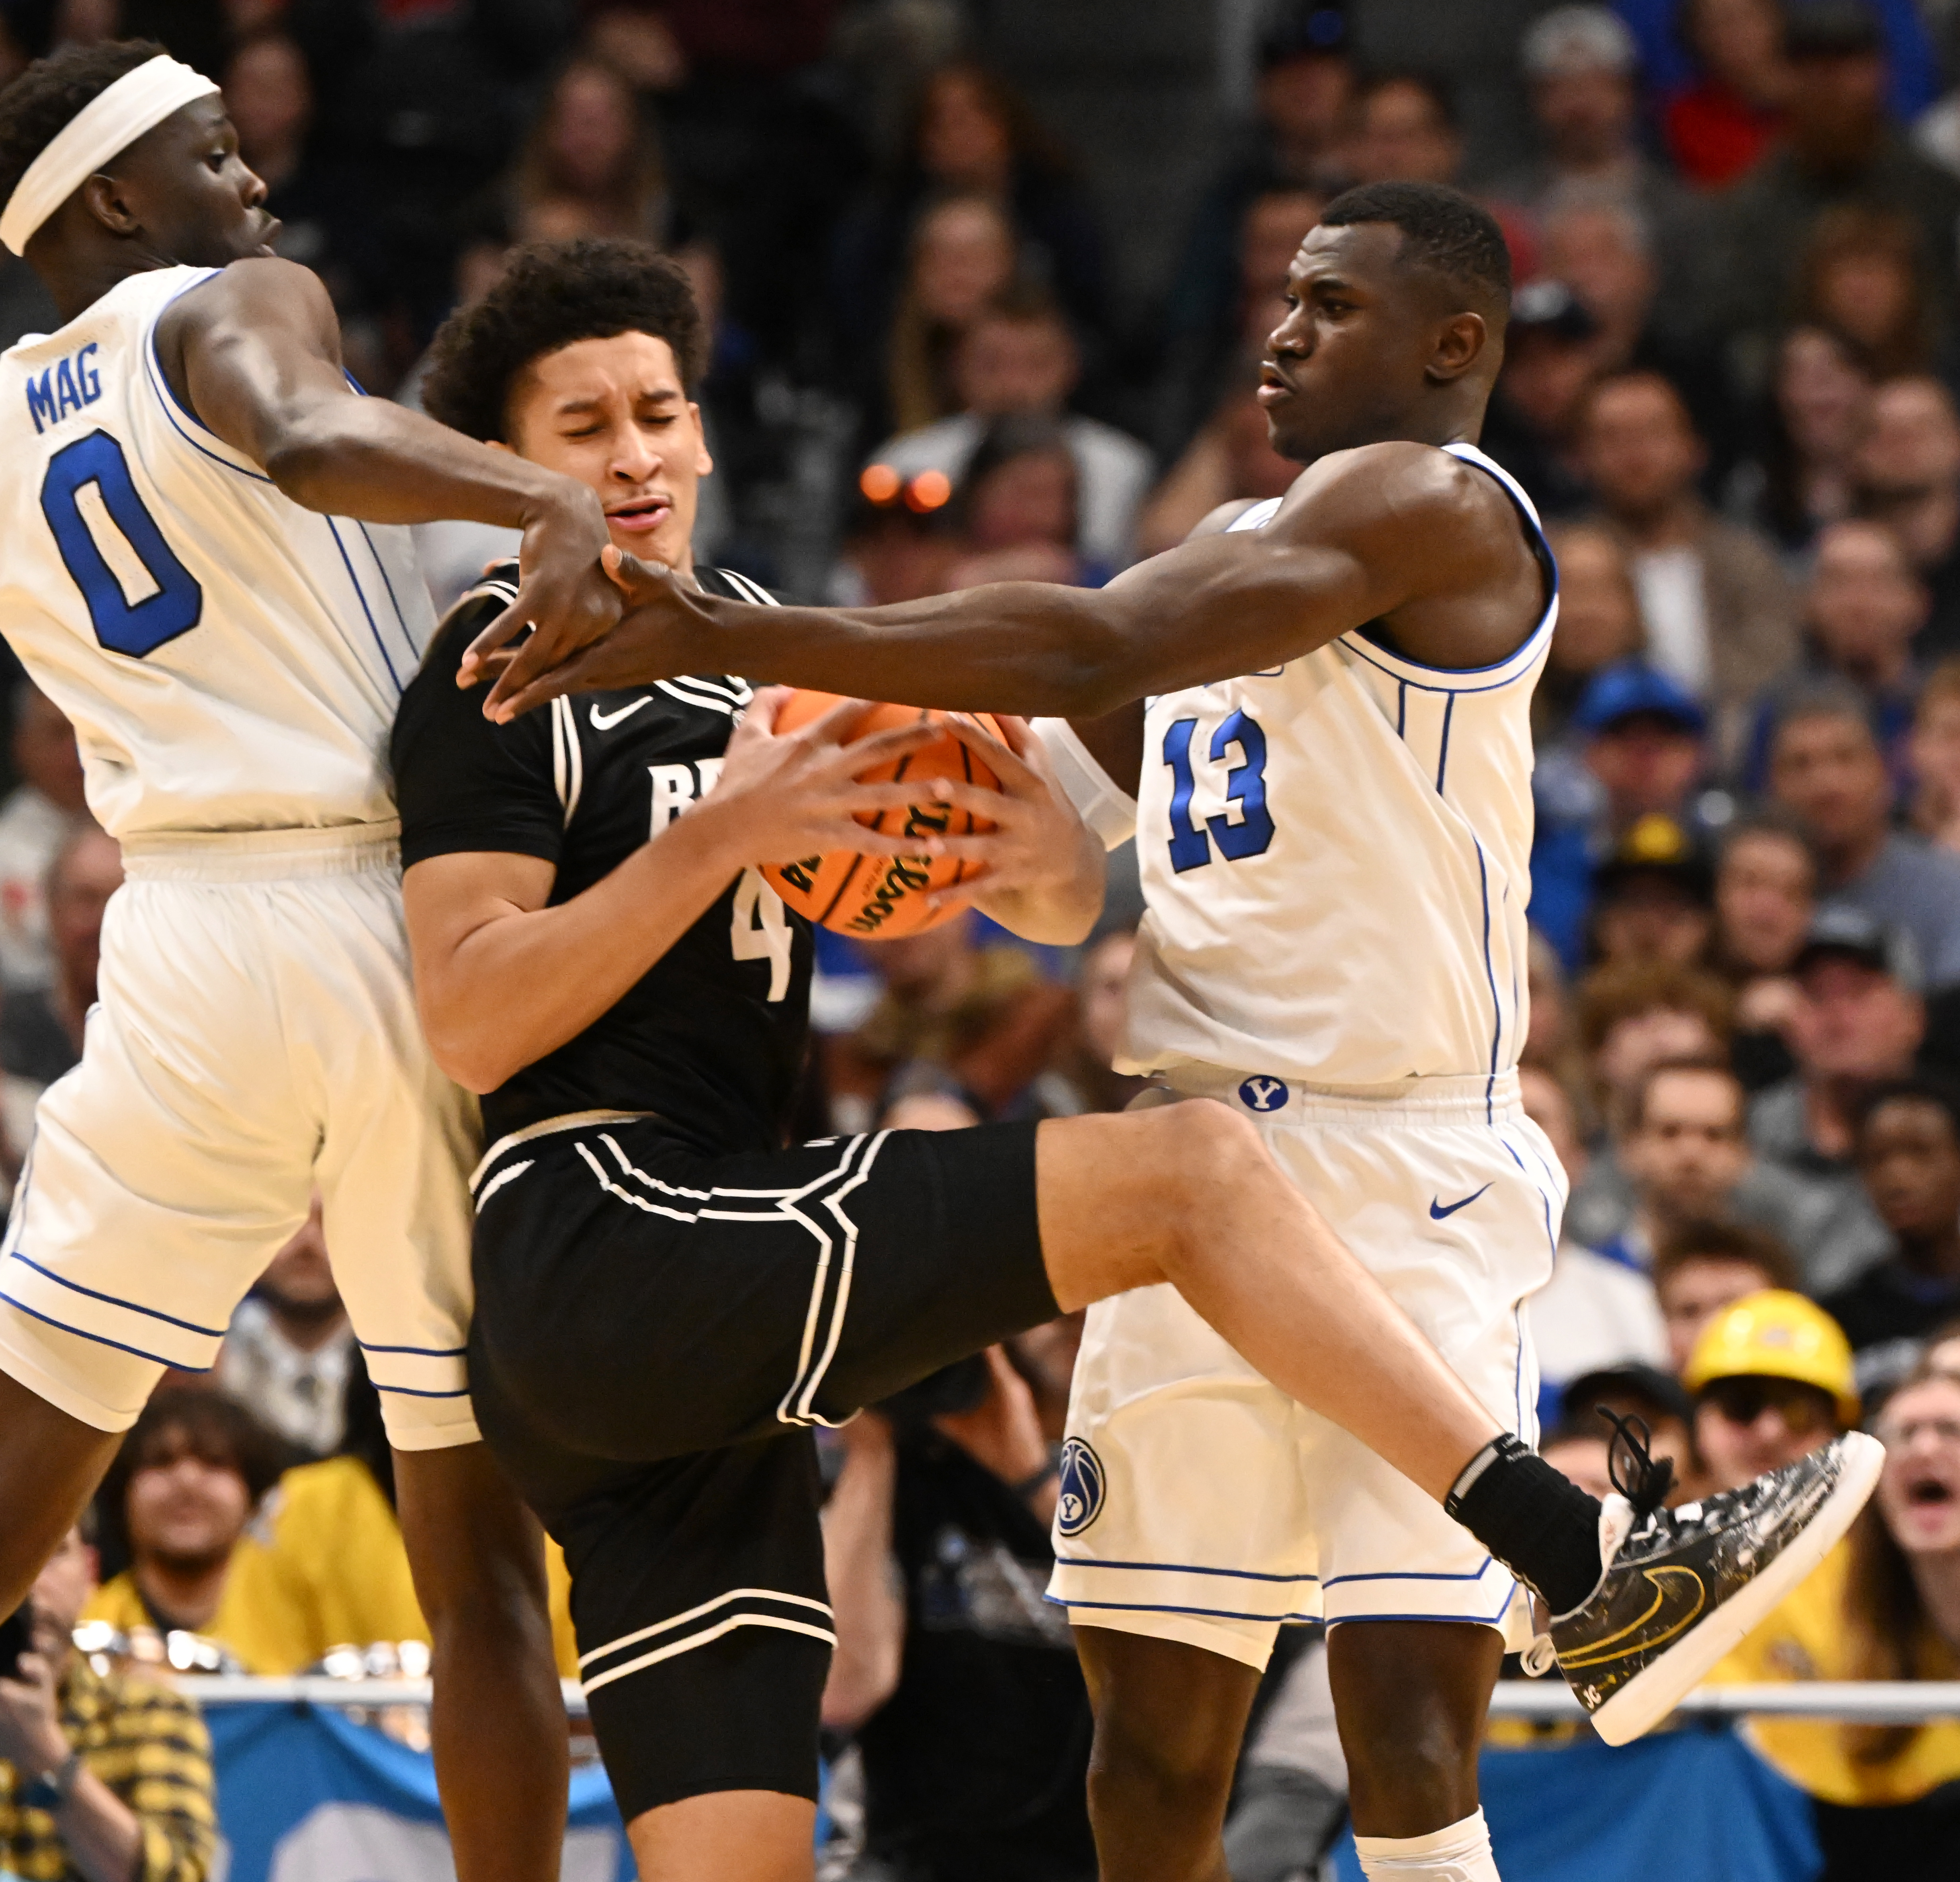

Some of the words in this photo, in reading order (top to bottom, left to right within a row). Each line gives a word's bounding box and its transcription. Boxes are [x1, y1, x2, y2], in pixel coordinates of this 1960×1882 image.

[26, 342, 102, 434] MAG
[40, 428, 202, 659] 0
[1163, 707, 1276, 874] 13
[731, 865, 793, 1002] 4
[1246, 1078, 1281, 1109] Y
[1063, 1496, 1078, 1519] Y
